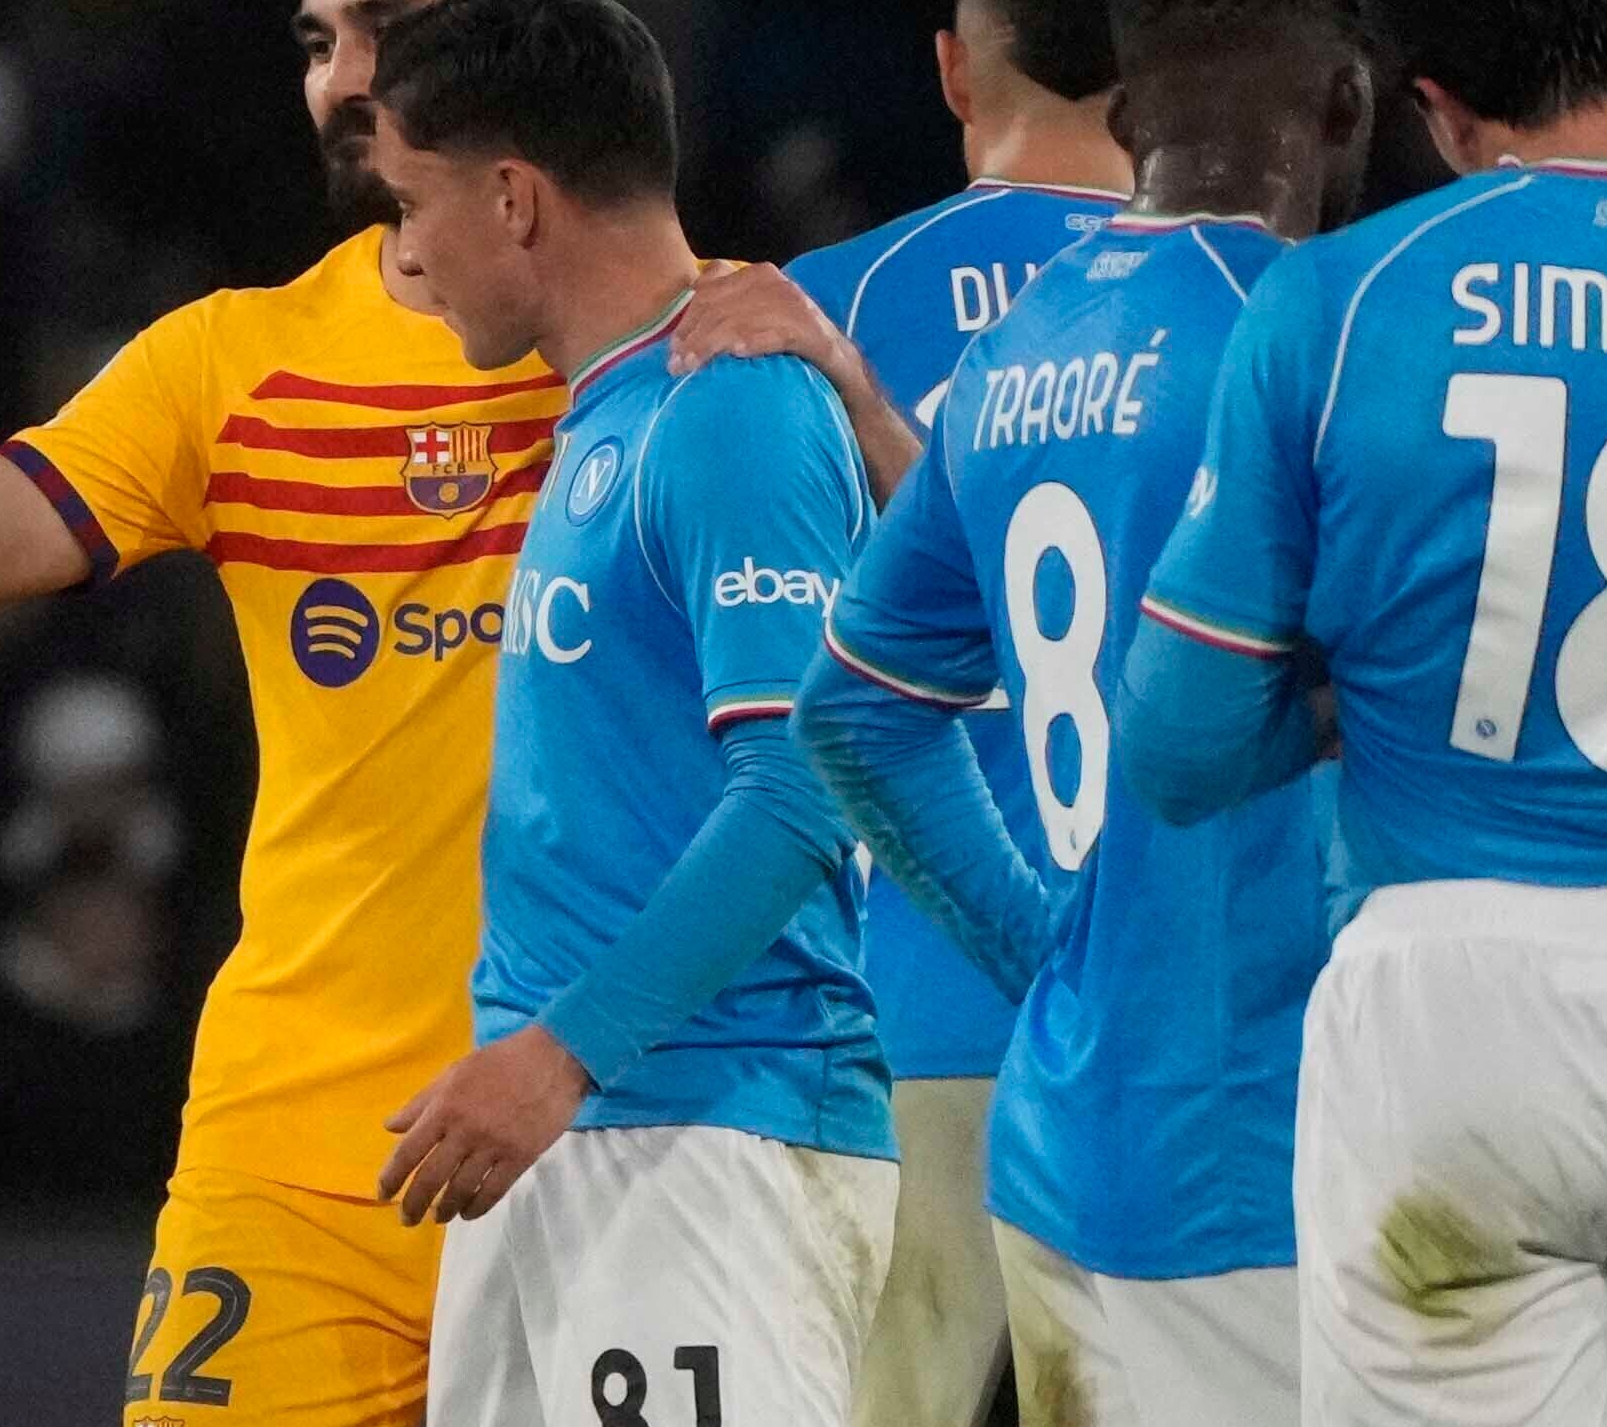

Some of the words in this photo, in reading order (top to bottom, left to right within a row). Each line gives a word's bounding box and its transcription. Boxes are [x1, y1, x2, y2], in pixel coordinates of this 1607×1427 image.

[973, 327, 1168, 452] TRAORÉ
[714, 555, 842, 619] ebay
[1003, 481, 1111, 872] 8
[124, 1266, 253, 1408] 22
